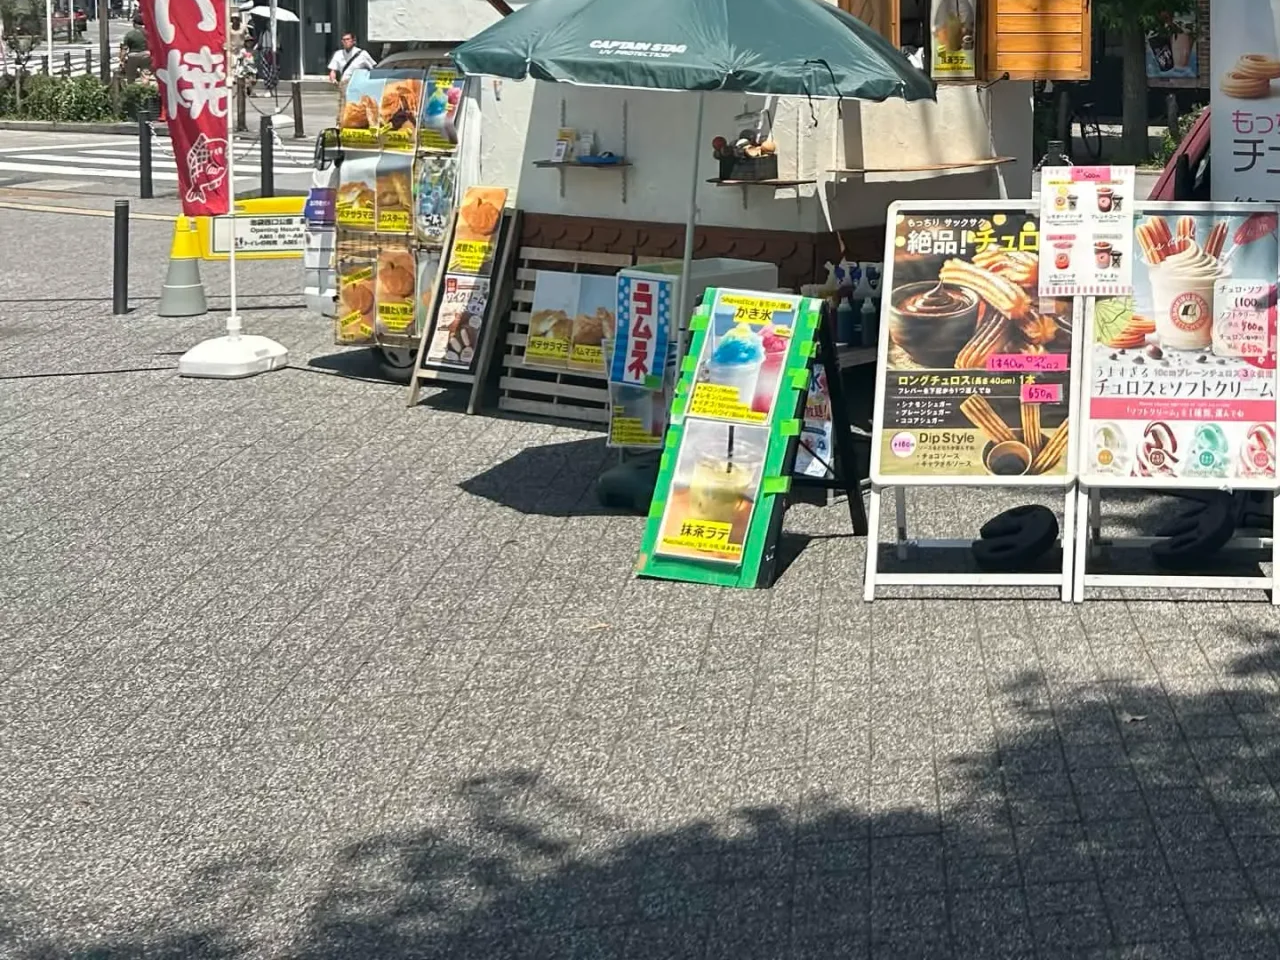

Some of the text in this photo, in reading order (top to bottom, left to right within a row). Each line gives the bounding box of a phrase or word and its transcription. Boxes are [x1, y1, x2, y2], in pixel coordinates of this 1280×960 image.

[589, 40, 687, 53] CAPTAIN STAG
[614, 50, 671, 58] PROTECTION
[908, 218, 985, 227] もっちり サックサク
[735, 307, 772, 320] かき氷
[628, 283, 653, 380] ラムネ
[530, 339, 569, 354] ポテサラマヨ
[1019, 375, 1036, 385] 1本
[1094, 377, 1275, 398] チュロスとソフトクリーム
[901, 401, 952, 409] シナモンシュガー
[901, 409, 951, 417] プレーンシュガー
[900, 417, 944, 425] ココアシュガー
[919, 432, 975, 444] Dip Style
[680, 523, 729, 540] 抹茶ラテ
